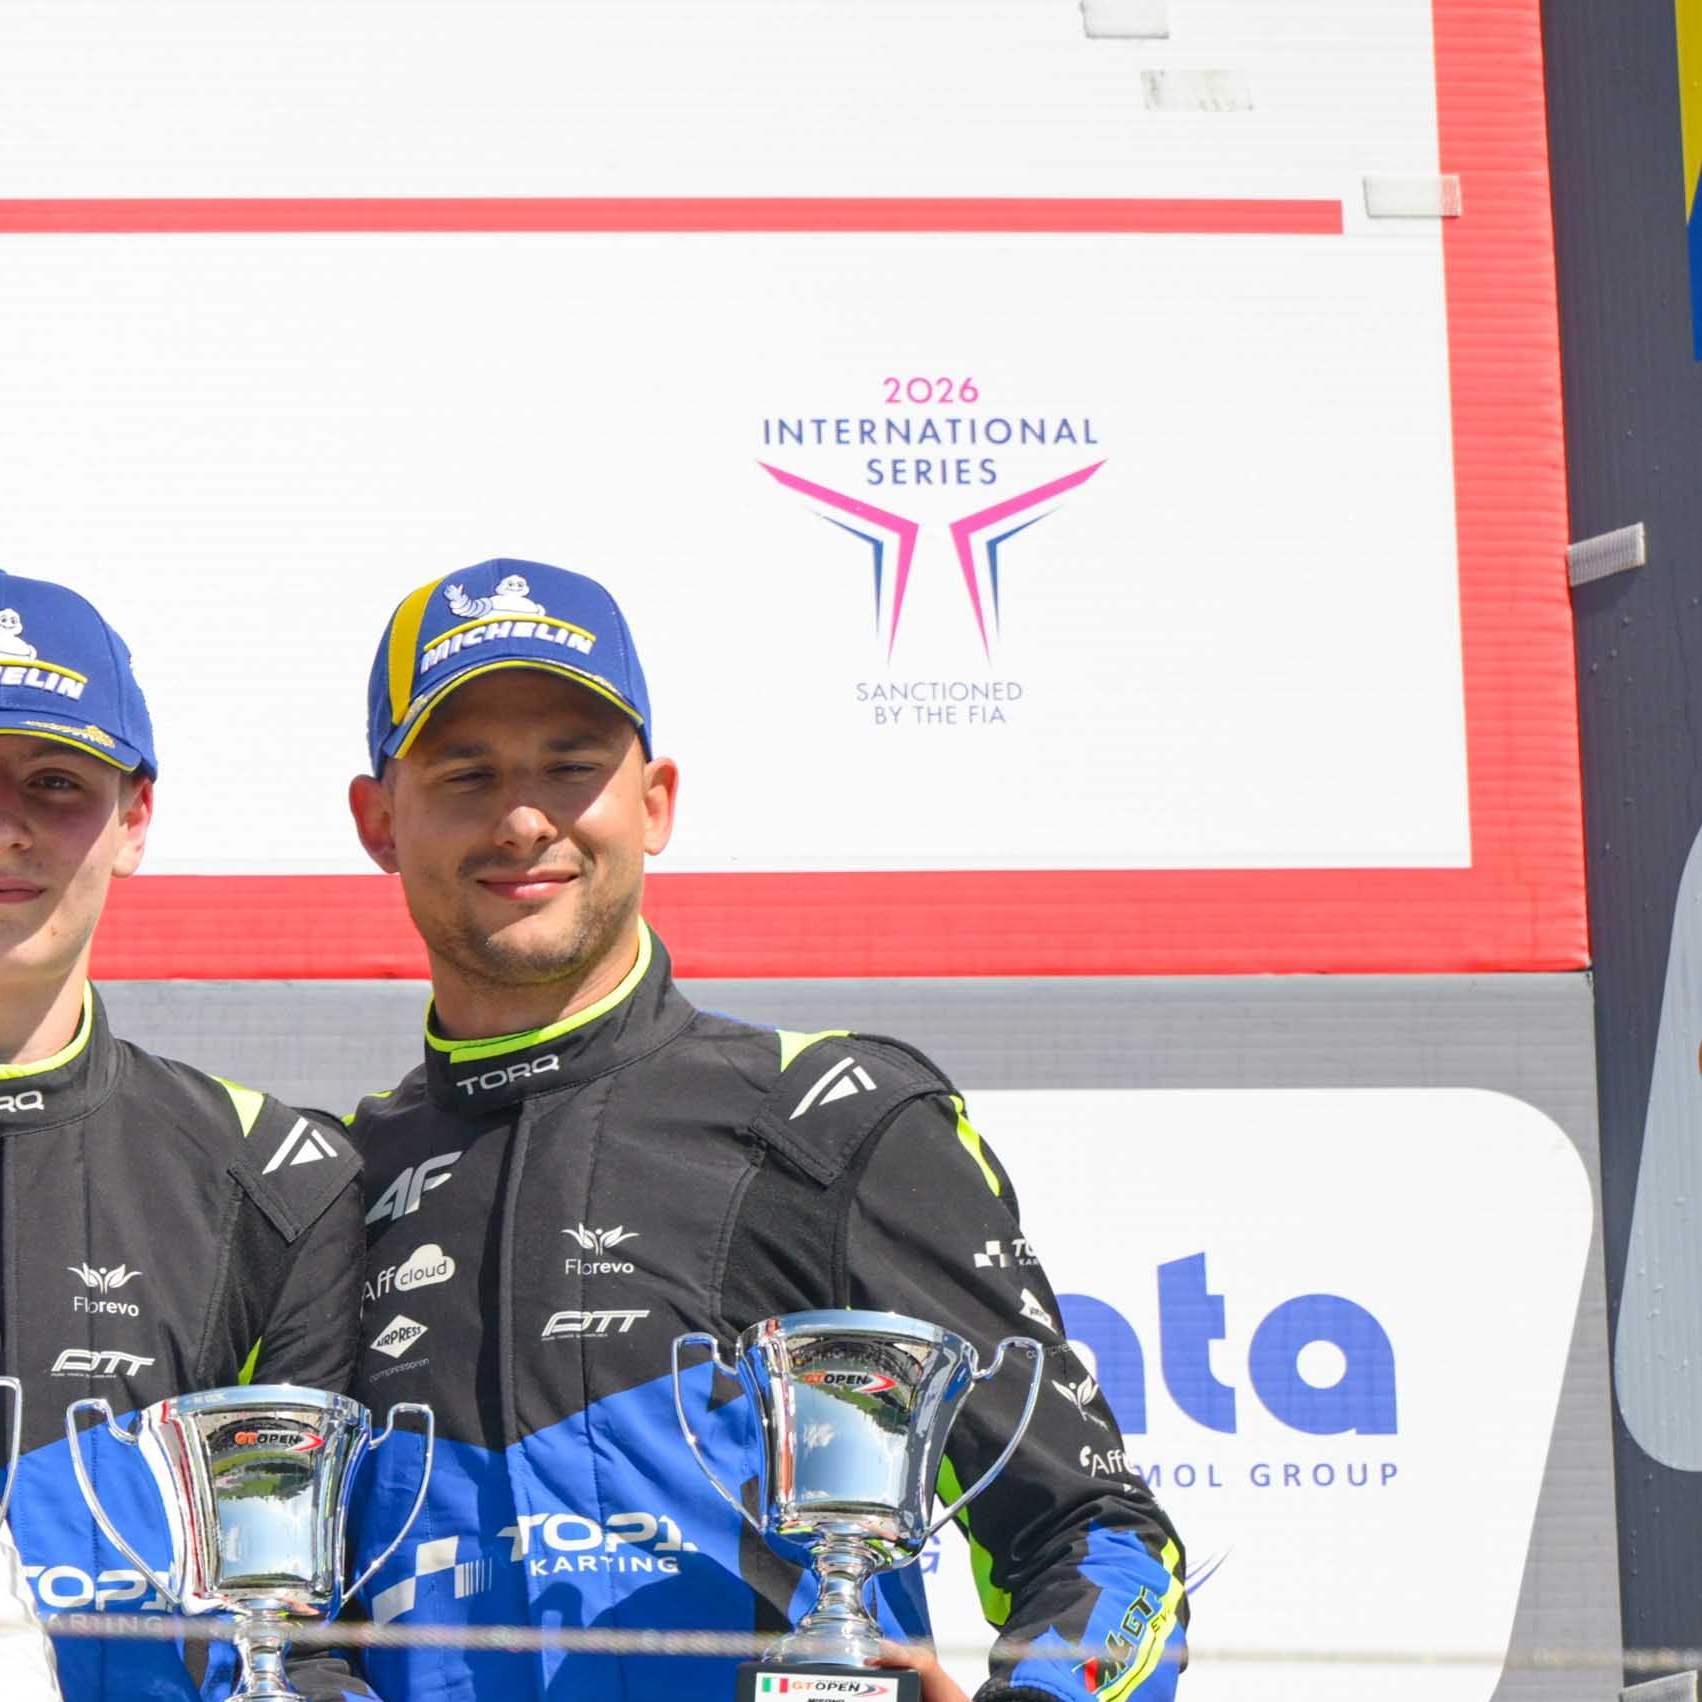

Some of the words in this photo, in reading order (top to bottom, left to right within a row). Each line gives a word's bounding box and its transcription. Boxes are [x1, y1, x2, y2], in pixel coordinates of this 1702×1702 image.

[883, 376, 980, 404] 2026
[762, 417, 1099, 445] INTERNATIONAL
[866, 458, 998, 485] SERIES
[419, 619, 596, 673] MICHELIN
[855, 681, 1024, 702] SANCTIONED
[874, 705, 902, 725] BY
[913, 705, 957, 725] THE
[968, 705, 1006, 725] FIA
[456, 1053, 561, 1096] TORQ
[564, 1258, 635, 1276] Florevo
[73, 1295, 140, 1317] Florevo
[376, 1325, 423, 1348] AIRPRESS
[1250, 1462, 1401, 1488] GROUP
[530, 1555, 681, 1577] KARTING
